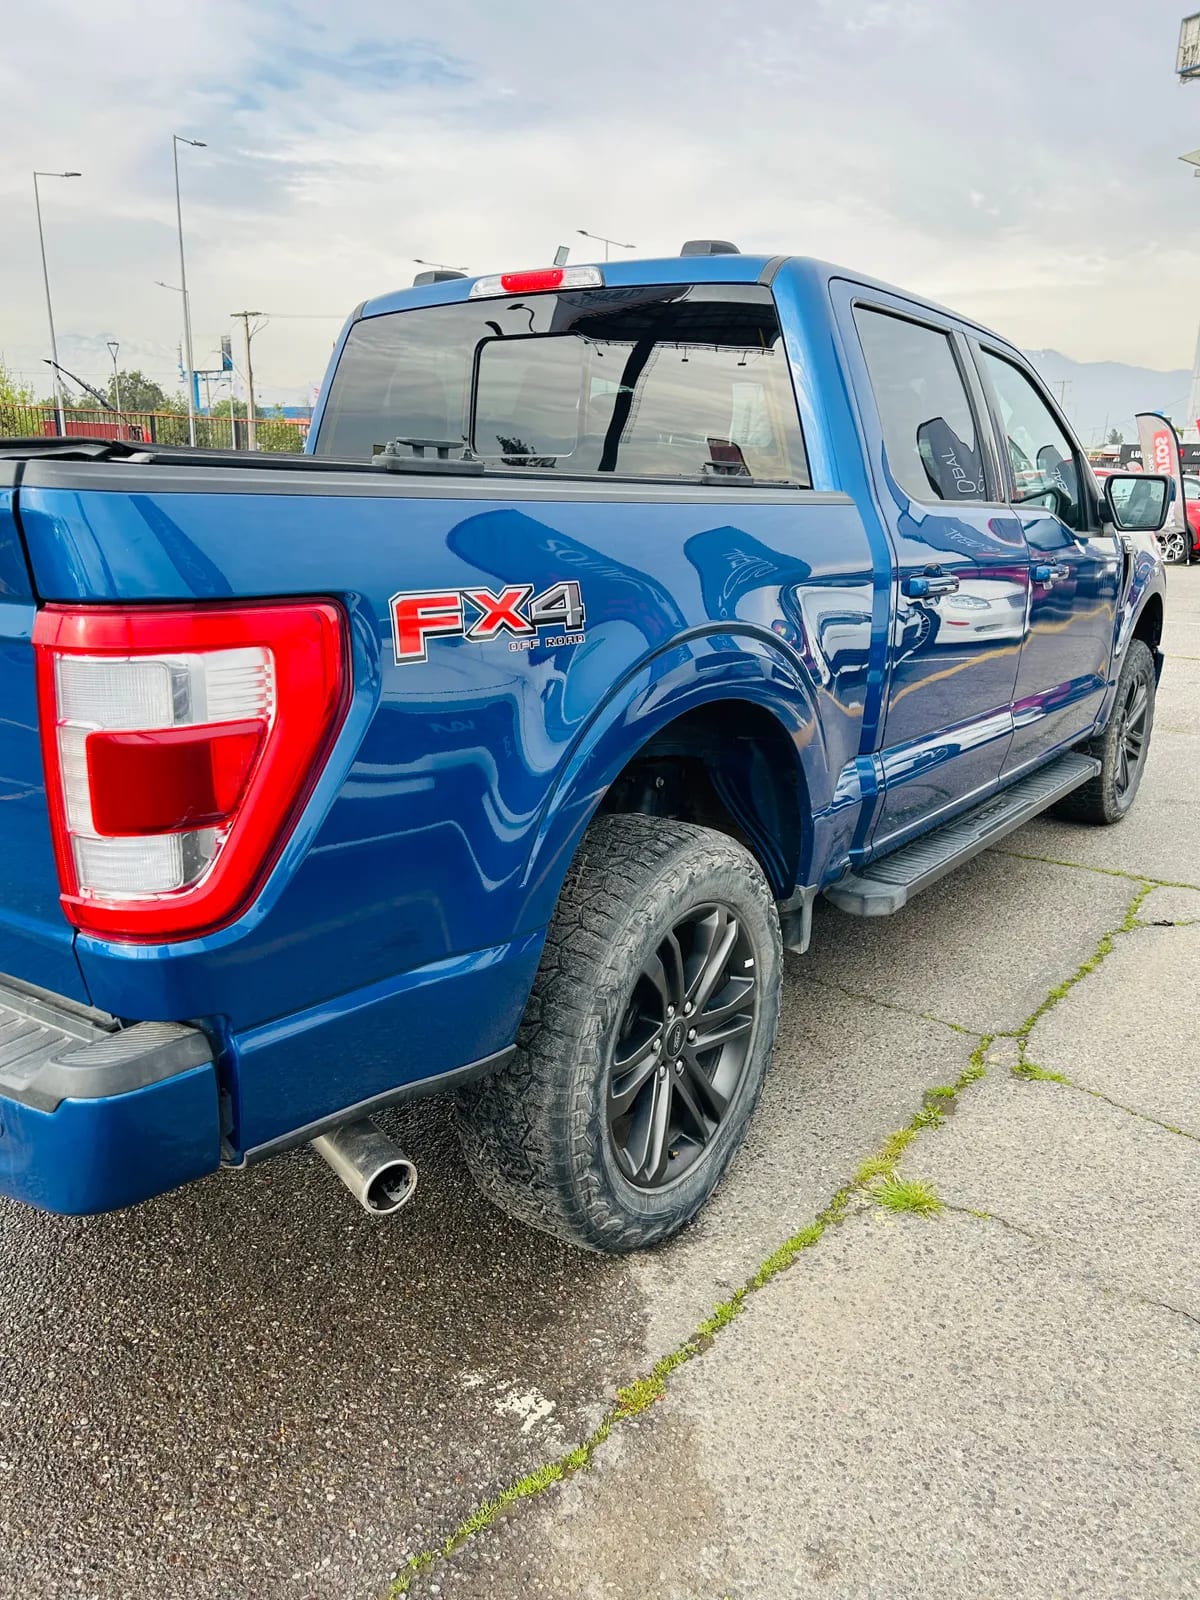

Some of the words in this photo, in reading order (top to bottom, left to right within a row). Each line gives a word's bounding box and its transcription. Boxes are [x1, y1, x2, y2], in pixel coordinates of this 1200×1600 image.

[389, 580, 586, 666] FX4
[508, 638, 541, 652] OFF
[545, 633, 585, 648] ROAD
